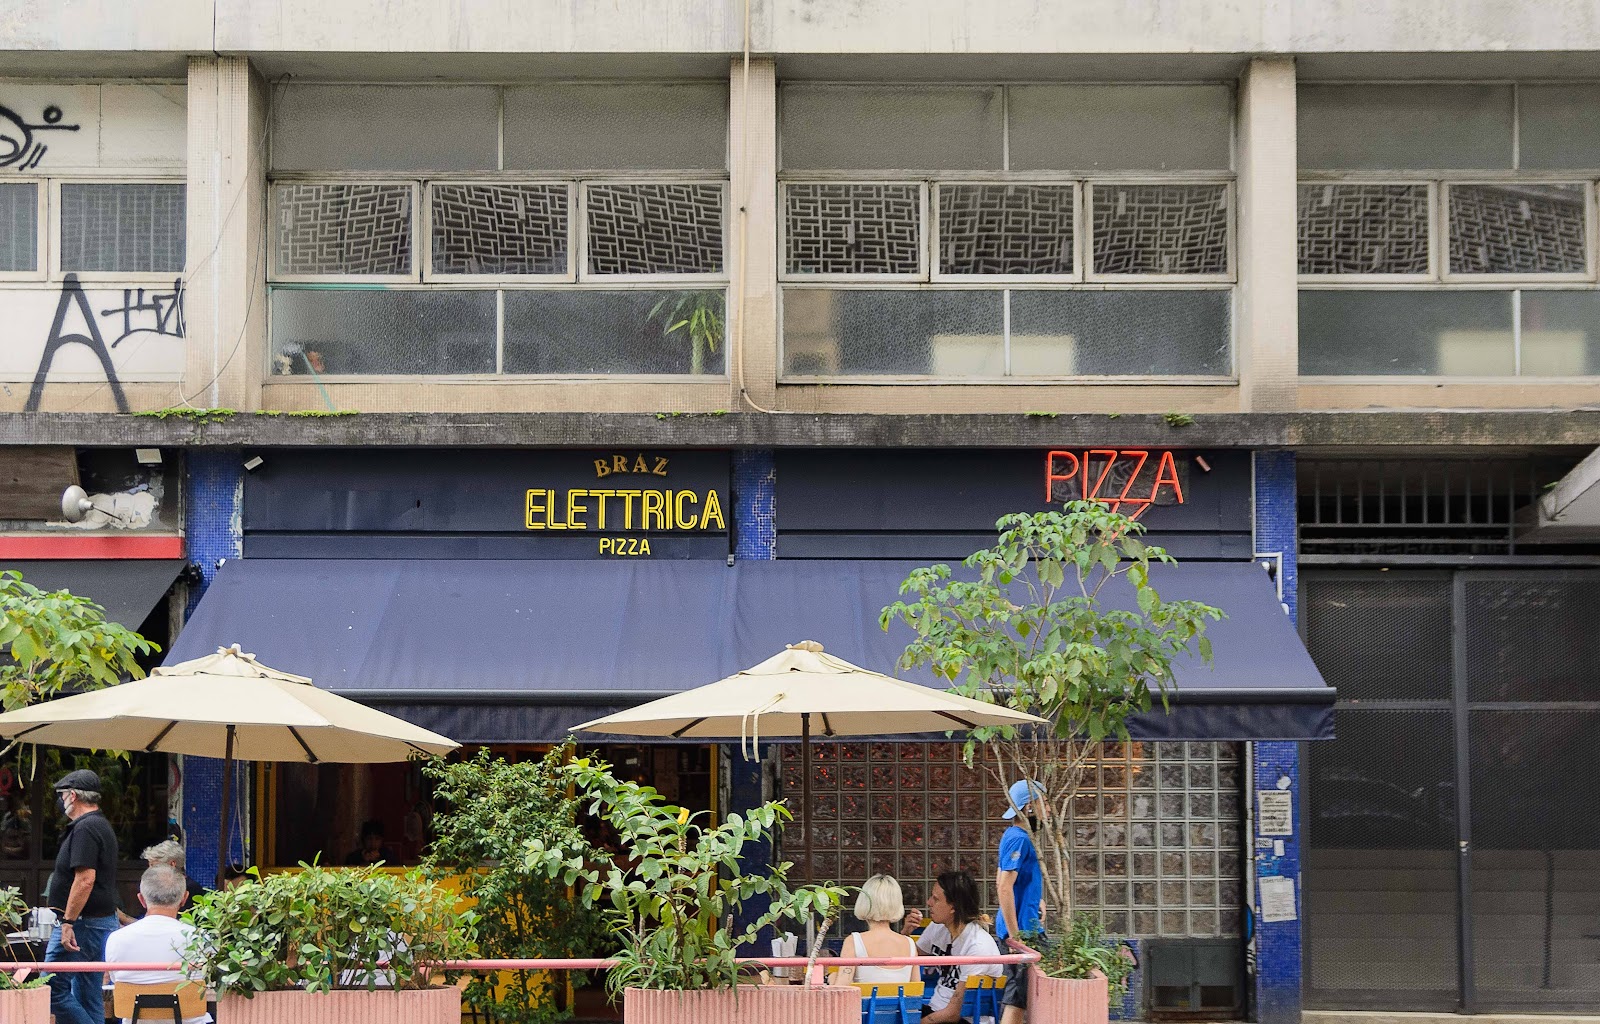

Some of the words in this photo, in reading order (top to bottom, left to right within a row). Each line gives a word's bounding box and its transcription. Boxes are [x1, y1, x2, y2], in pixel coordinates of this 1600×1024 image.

[1046, 450, 1184, 503] PIZZA
[525, 488, 726, 531] ELETTRICA
[599, 537, 651, 556] PIZZA
